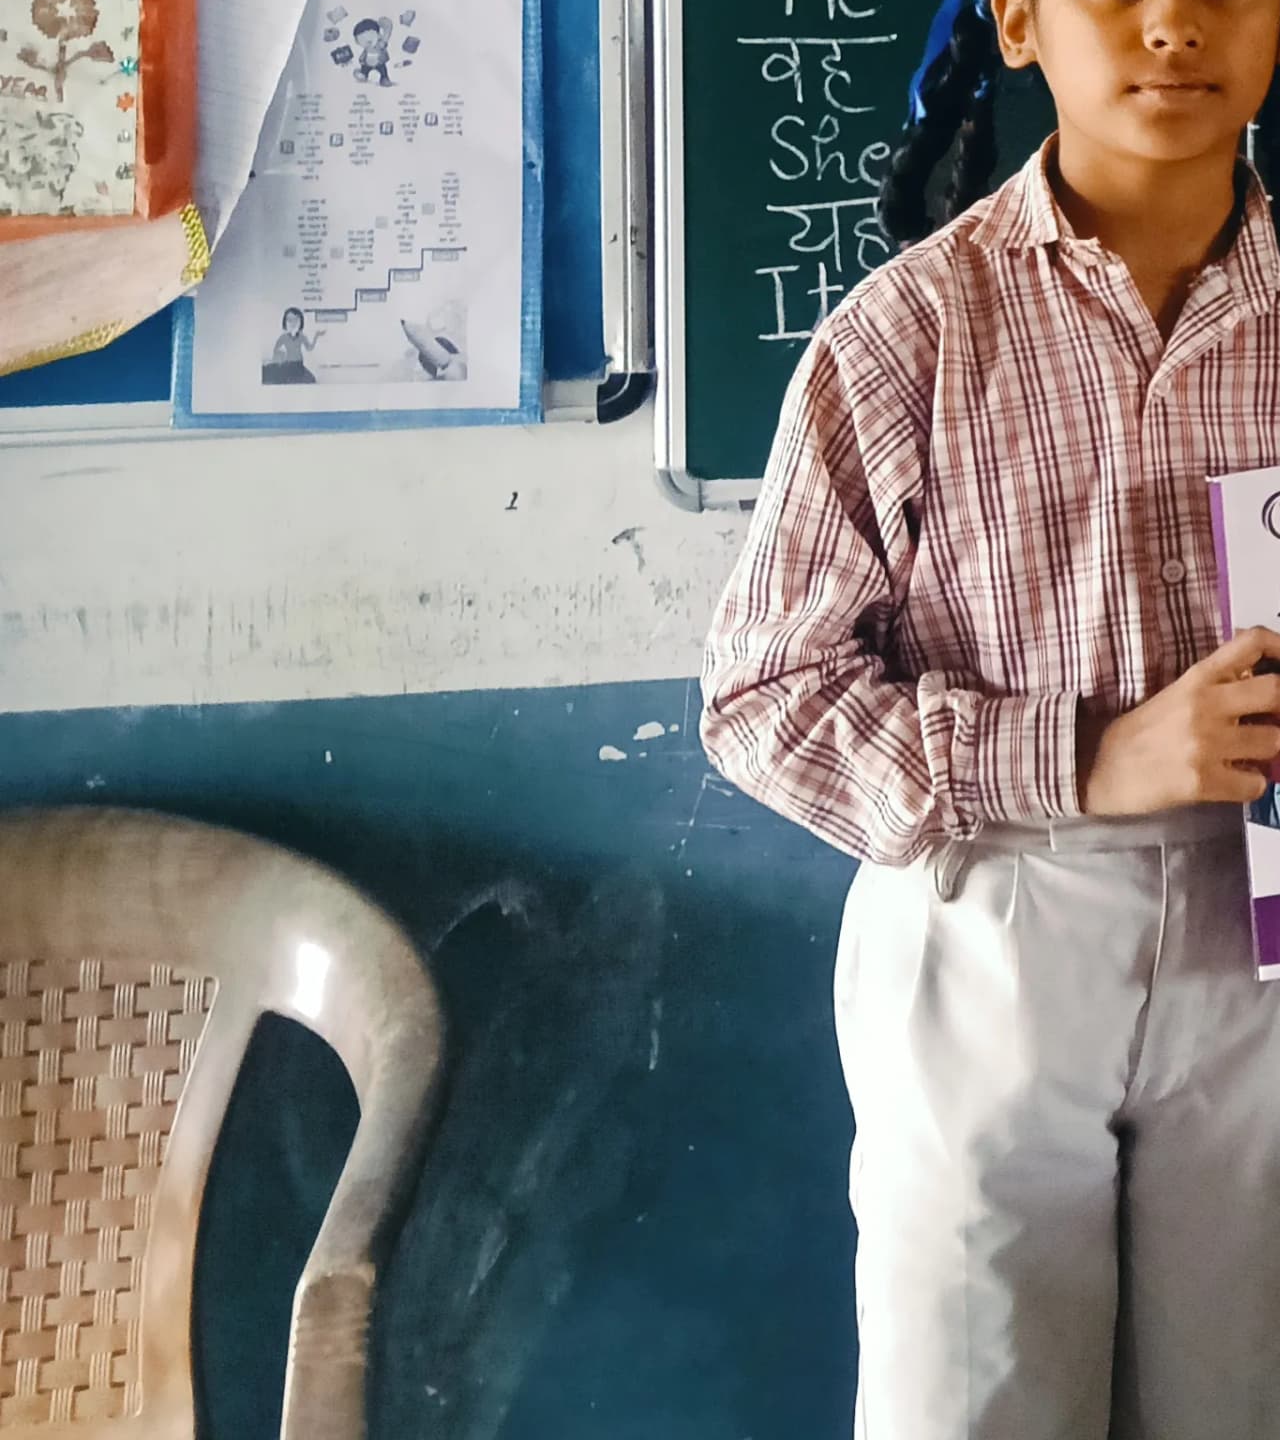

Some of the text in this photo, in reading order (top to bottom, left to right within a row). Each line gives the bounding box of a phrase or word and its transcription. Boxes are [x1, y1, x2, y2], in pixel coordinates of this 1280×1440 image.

[736, 33, 898, 113] वह
[769, 115, 892, 188] She
[766, 196, 891, 272] यह
[755, 264, 845, 341] It
